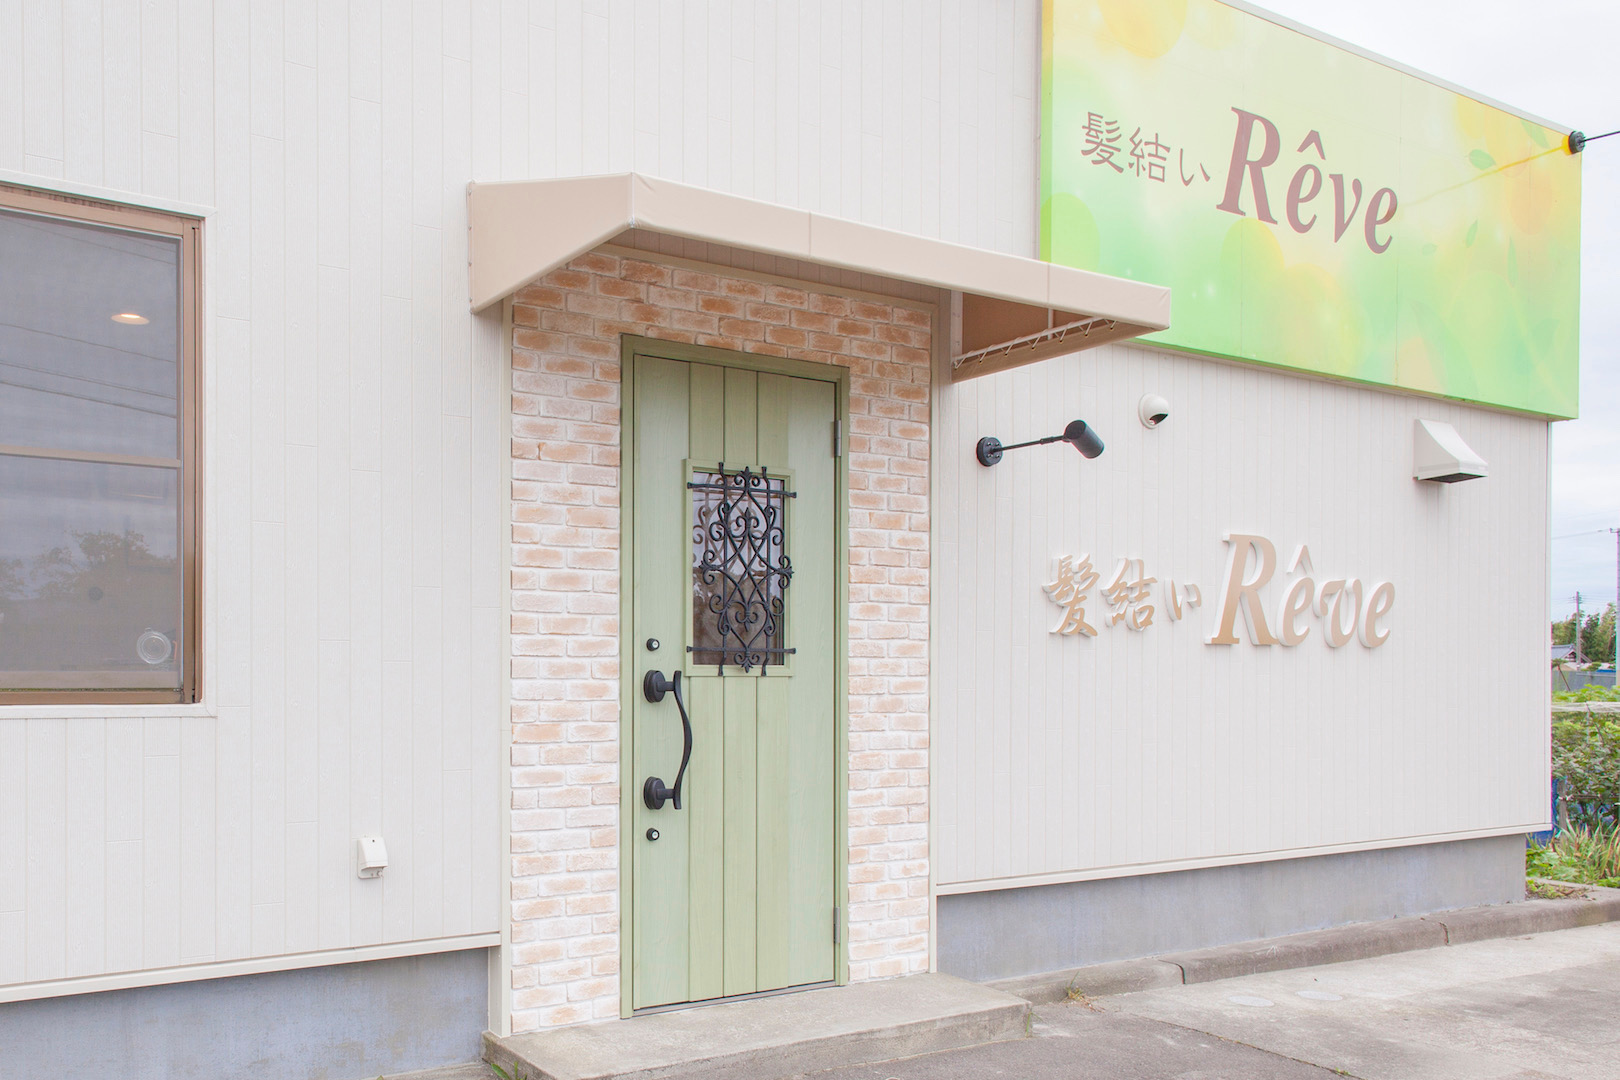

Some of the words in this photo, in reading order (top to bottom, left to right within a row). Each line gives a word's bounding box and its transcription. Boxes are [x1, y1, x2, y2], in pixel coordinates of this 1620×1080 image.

[1081, 111, 1211, 187] 髪結い
[1216, 106, 1398, 254] Rêve
[1042, 552, 1202, 637] 髪結い
[1204, 533, 1396, 648] Rêve
